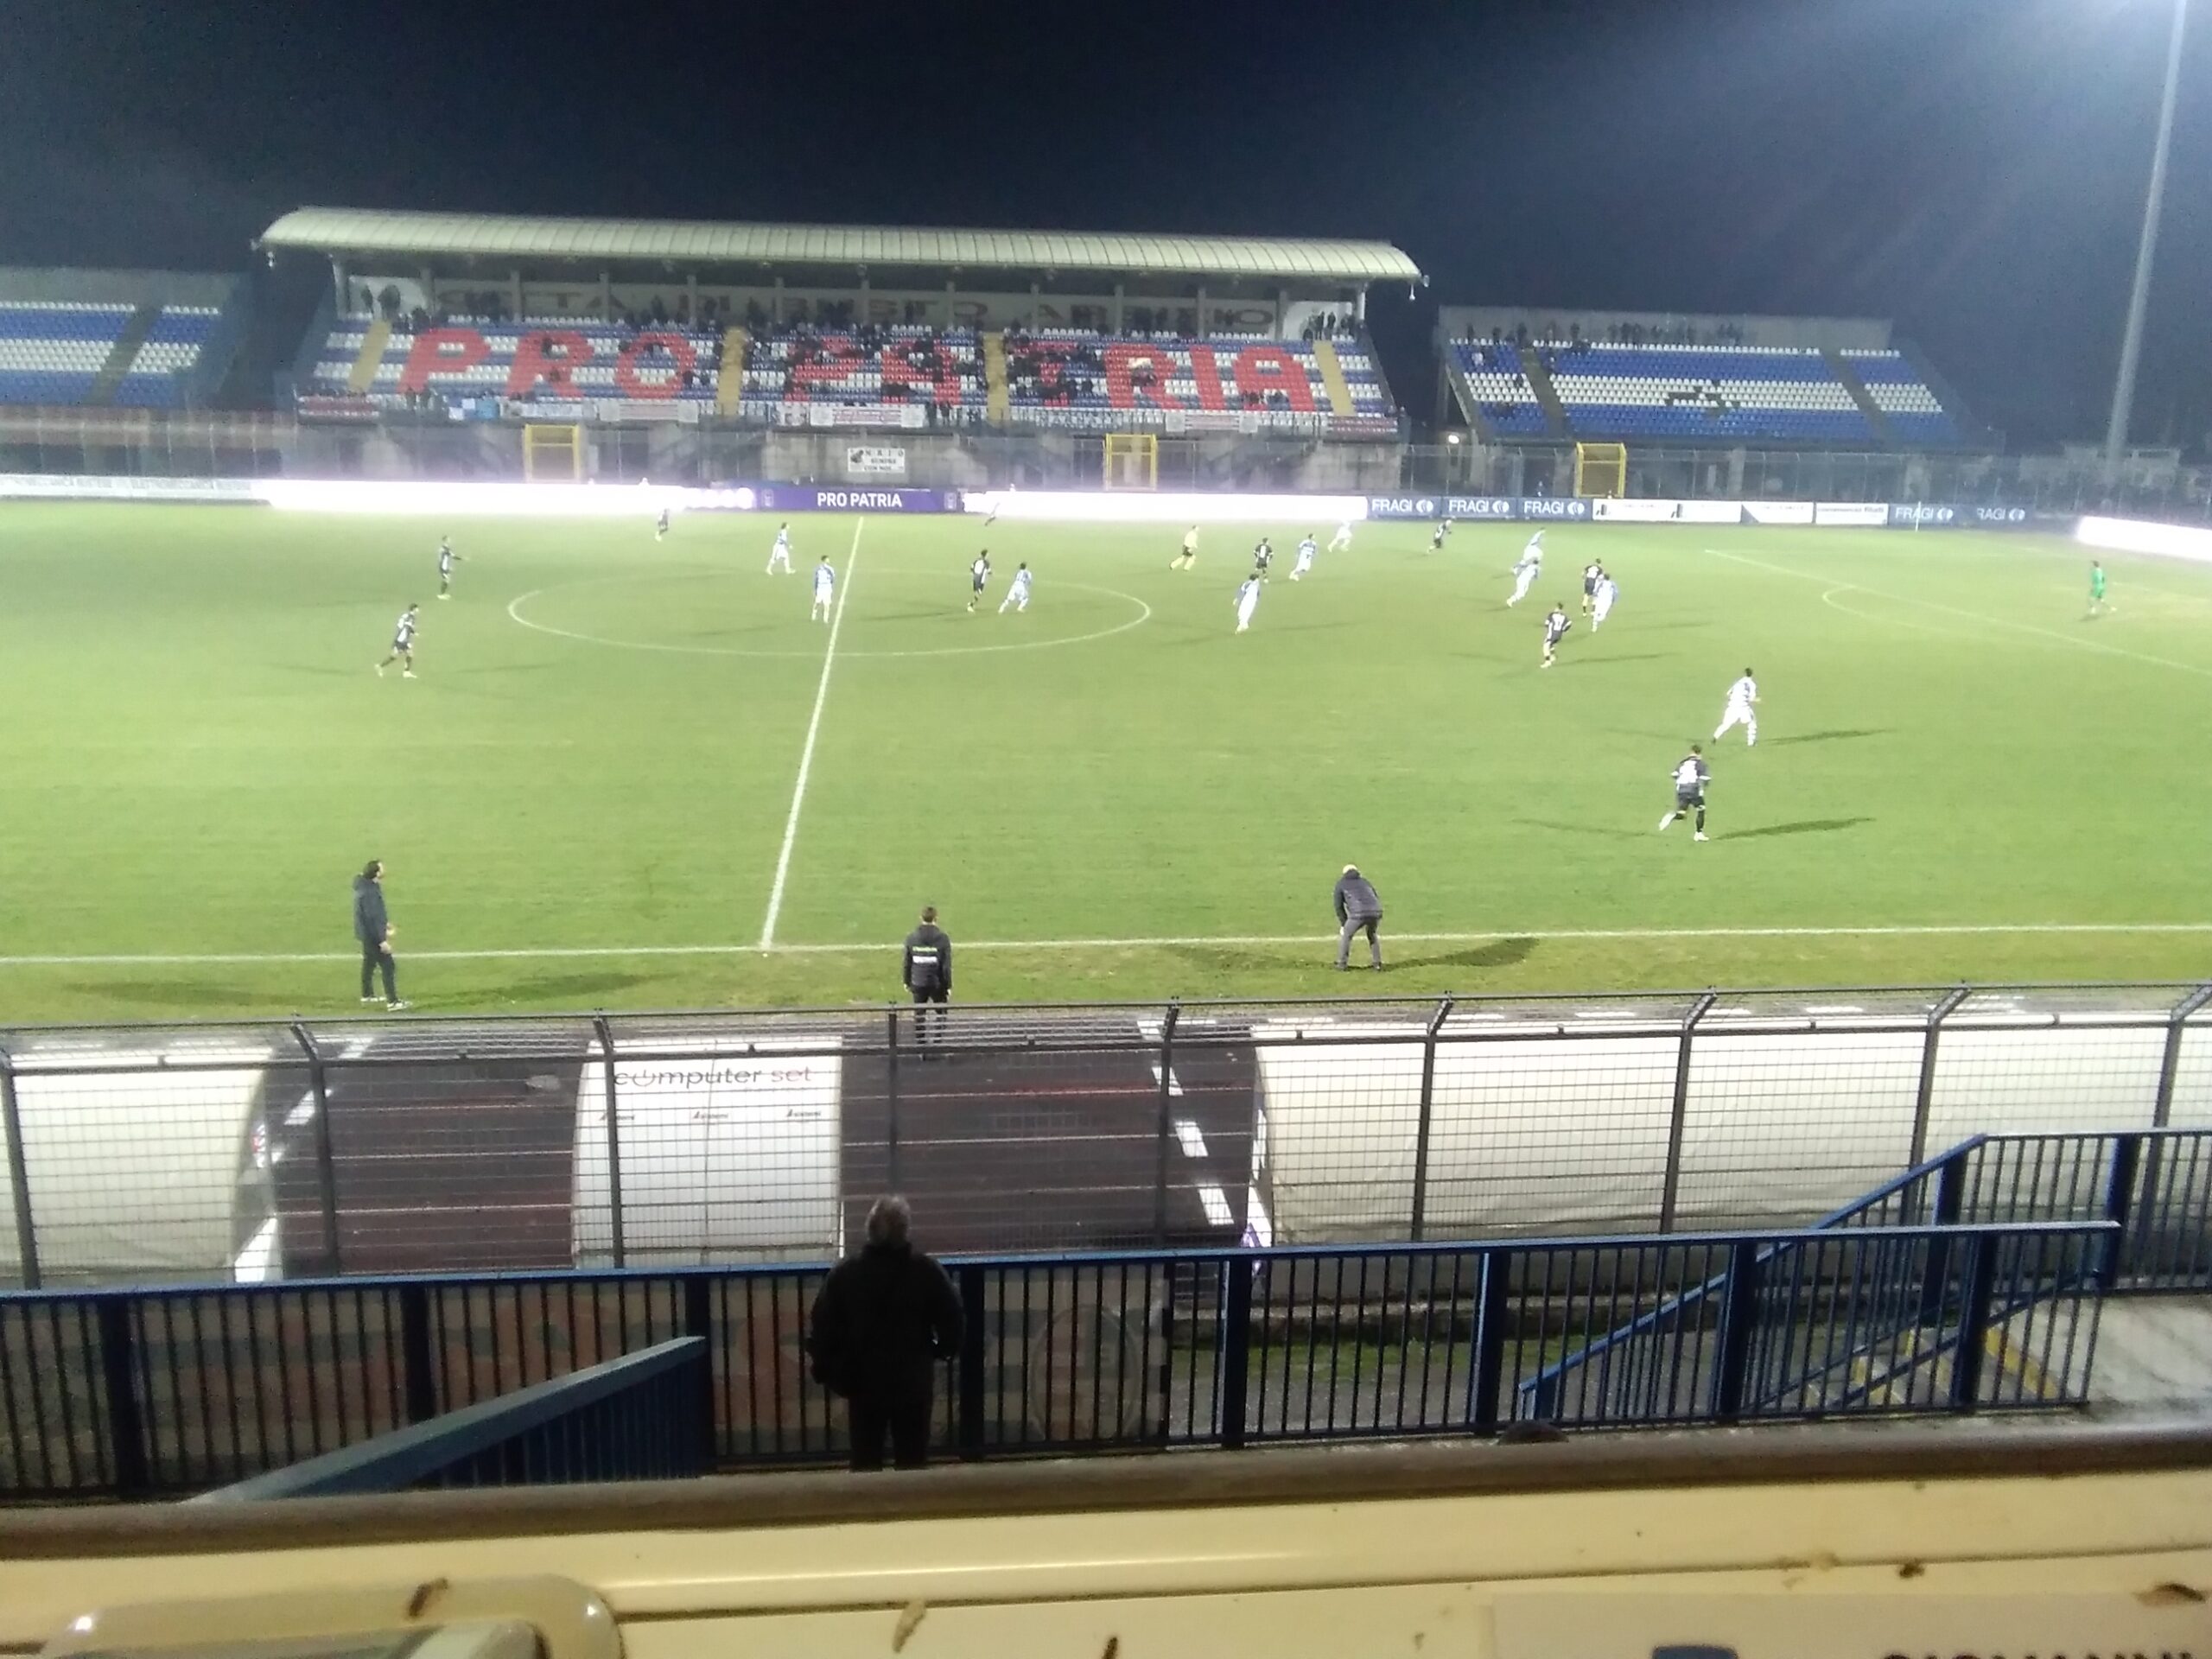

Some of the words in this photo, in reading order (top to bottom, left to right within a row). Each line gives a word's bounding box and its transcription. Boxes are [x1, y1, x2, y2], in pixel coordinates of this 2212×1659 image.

[396, 327, 698, 401] PRO
[817, 492, 848, 507] PRO
[850, 492, 903, 508] PATRIA
[1371, 499, 1413, 513] FRAGI
[1448, 499, 1490, 514] FRAGI
[1523, 499, 1565, 515] FRAGI
[1895, 506, 1934, 519] FRAGI
[613, 1067, 763, 1089] computer
[771, 1066, 811, 1083] set
